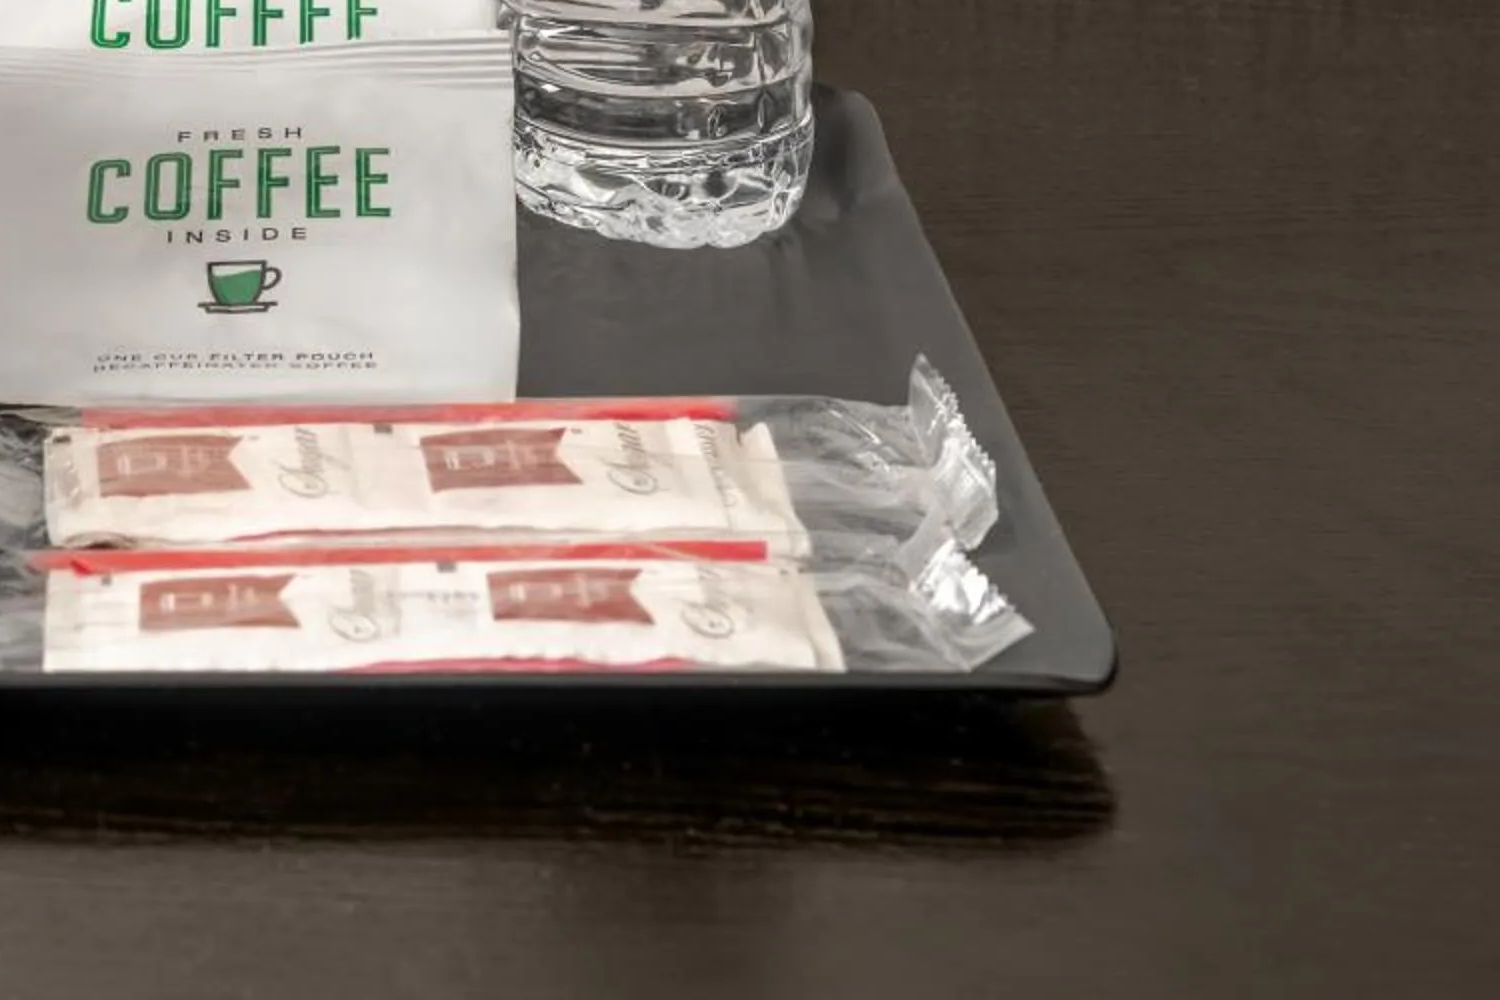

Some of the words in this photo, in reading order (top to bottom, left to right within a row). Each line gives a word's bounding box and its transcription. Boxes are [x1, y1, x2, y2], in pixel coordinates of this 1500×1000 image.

[176, 127, 303, 143] FRESH
[86, 146, 391, 223] COFFEE
[166, 227, 309, 245] INSIDE
[96, 353, 142, 363] ONE
[209, 352, 284, 362] FILTER
[295, 351, 375, 361] POUCH
